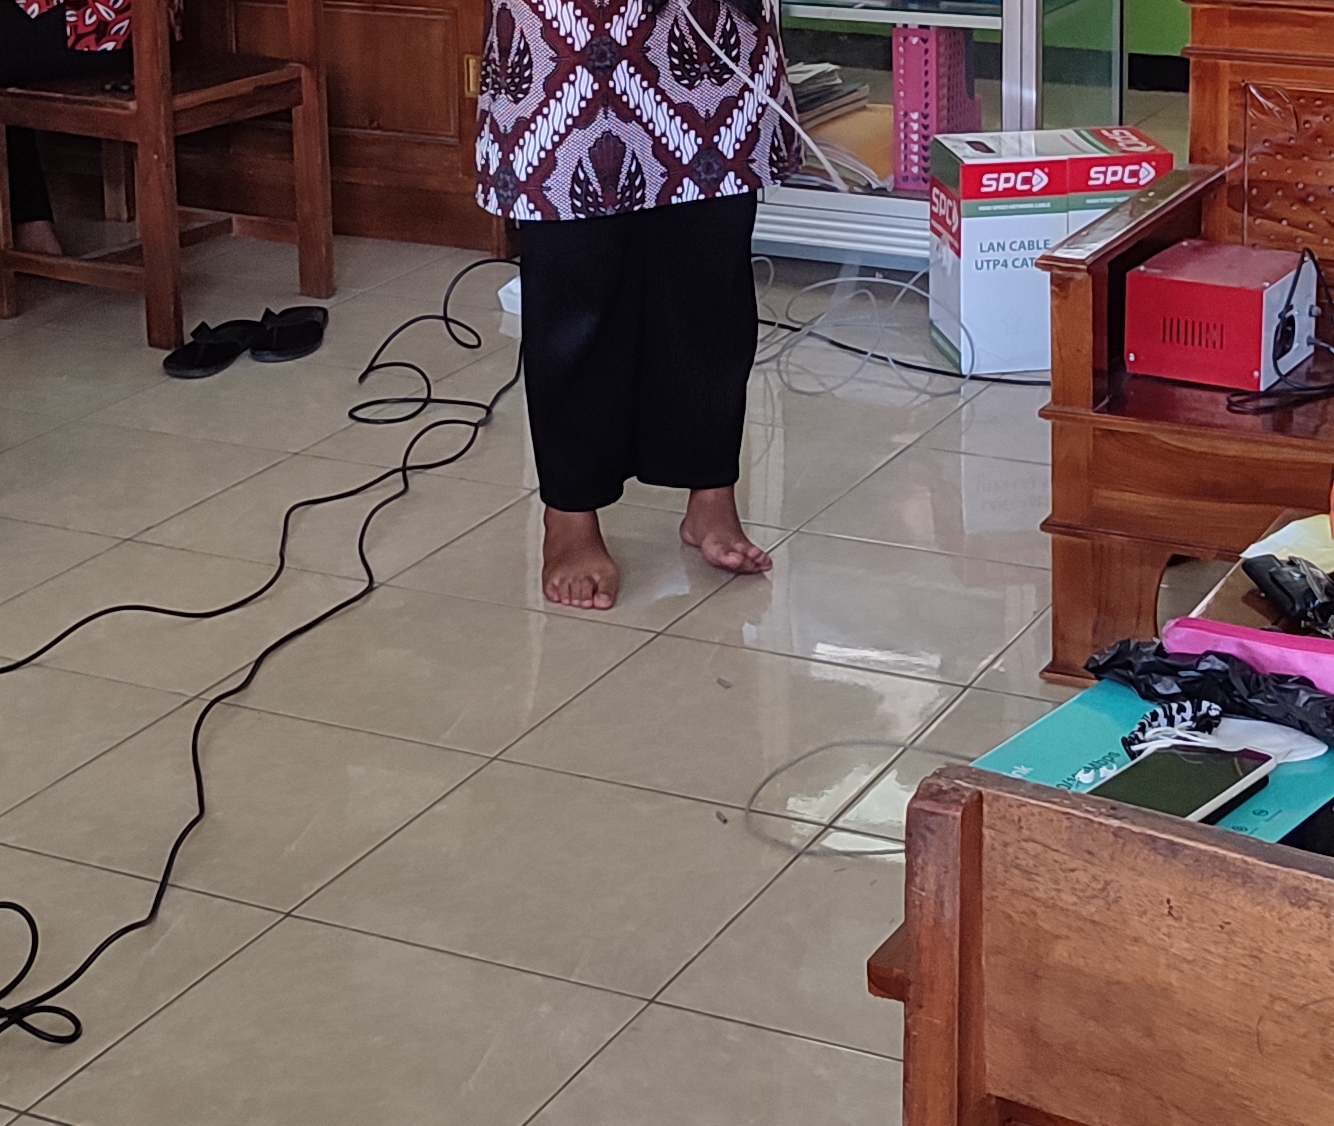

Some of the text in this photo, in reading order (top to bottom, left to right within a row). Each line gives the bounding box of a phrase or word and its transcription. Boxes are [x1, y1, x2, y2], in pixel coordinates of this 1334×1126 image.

[980, 171, 1033, 193] SPC
[1088, 165, 1140, 186] SPC
[931, 186, 952, 227] SPC
[979, 239, 1051, 254] LAN CABLE
[975, 259, 1008, 271] UTP4
